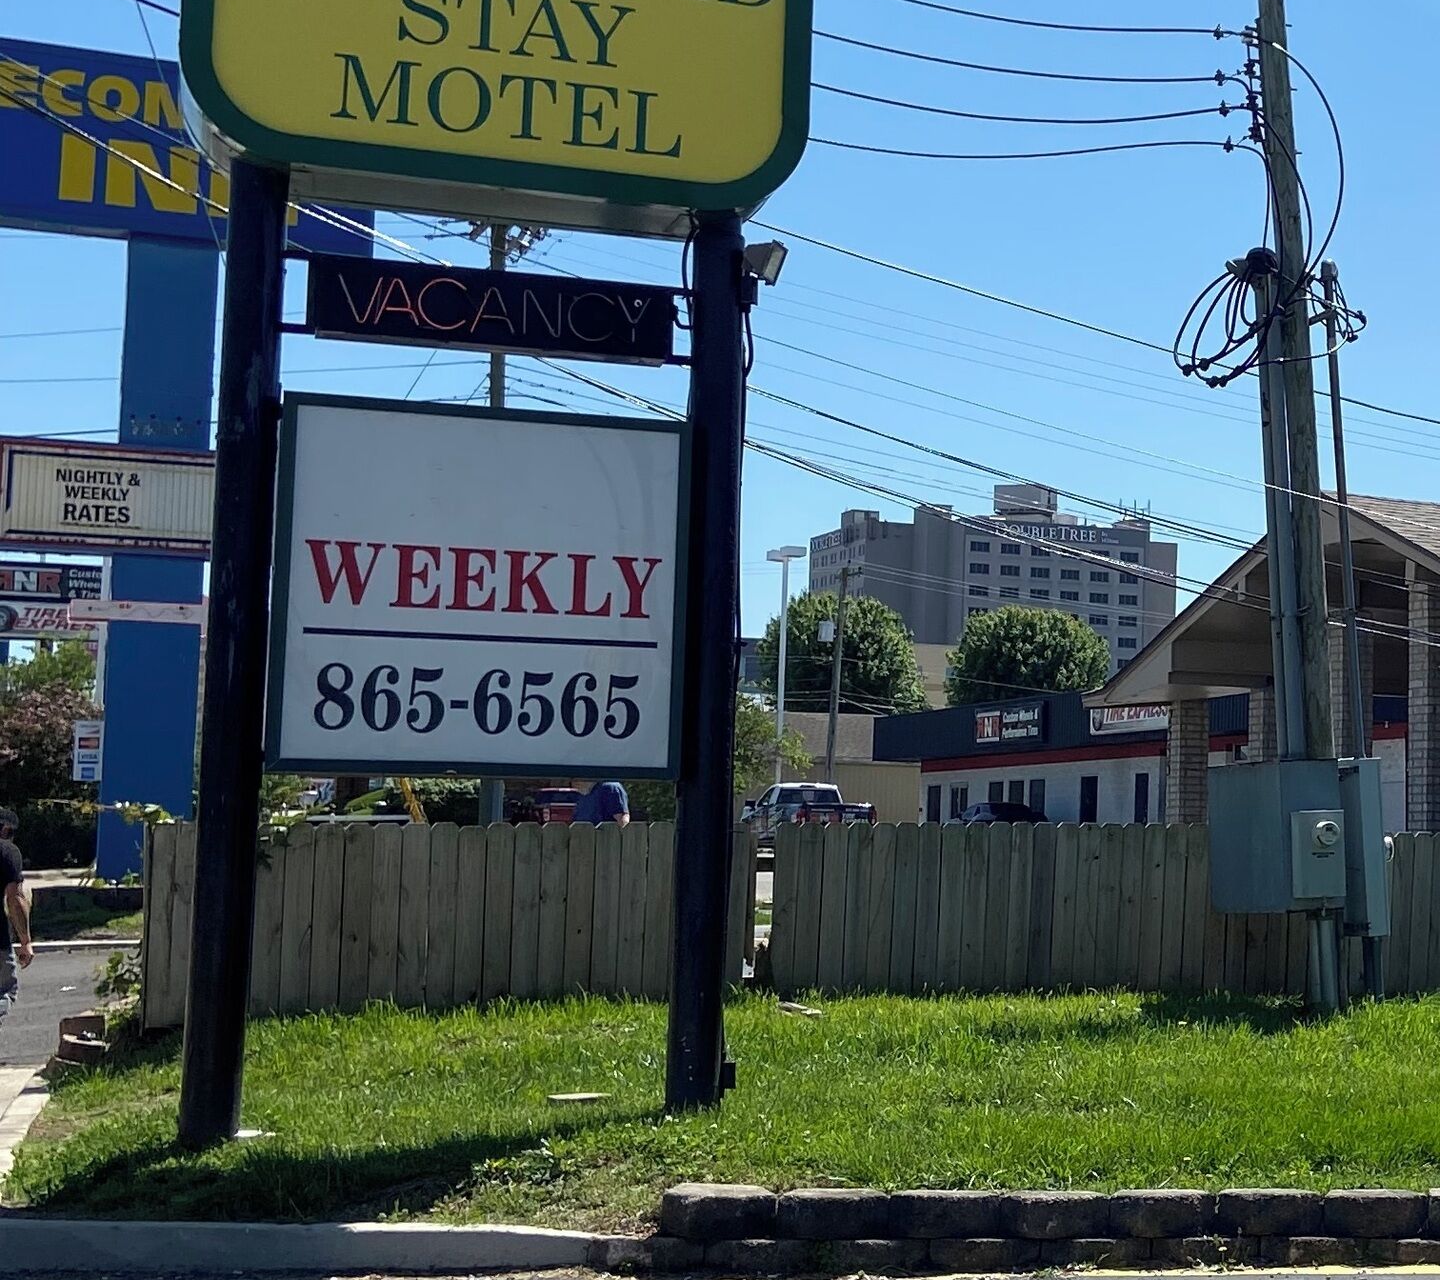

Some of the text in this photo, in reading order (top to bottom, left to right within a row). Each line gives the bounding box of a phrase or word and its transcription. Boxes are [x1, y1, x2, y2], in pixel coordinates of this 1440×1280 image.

[0, 61, 185, 129] ECON
[331, 53, 682, 158] MOTEL
[338, 273, 651, 342] VACANCY
[56, 468, 141, 487] NIGHTLY &
[65, 485, 129, 502] WEEKLY
[63, 502, 130, 523] RATES
[69, 579, 101, 589] Whee
[305, 539, 663, 618] WEEKLY
[314, 662, 641, 739] 865-6565
